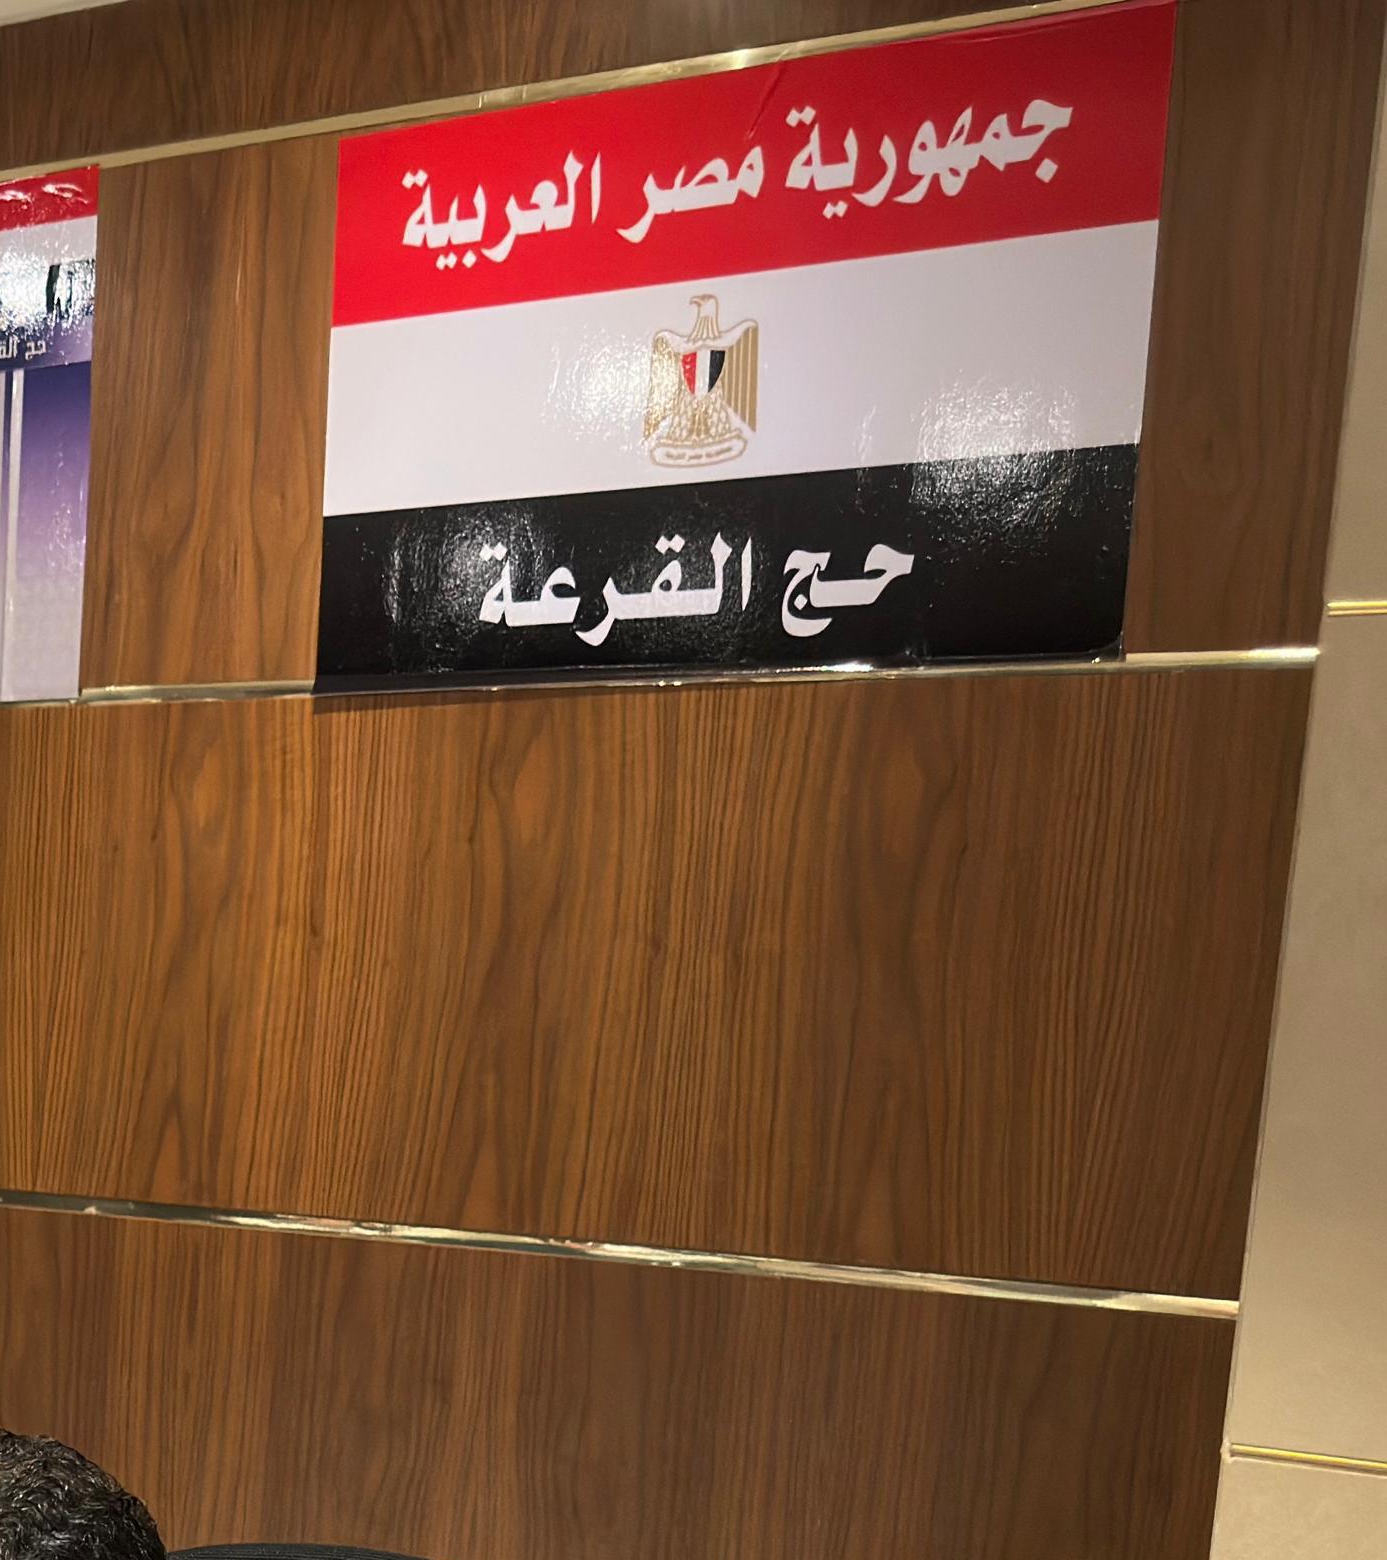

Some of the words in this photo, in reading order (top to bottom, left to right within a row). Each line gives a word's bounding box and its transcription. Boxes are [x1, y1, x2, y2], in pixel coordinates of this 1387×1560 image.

[402, 151, 601, 271] العربية
[617, 136, 765, 245] مصر
[785, 91, 1072, 218] جمهورية
[478, 532, 753, 647] القرعة
[781, 538, 914, 638] حج
